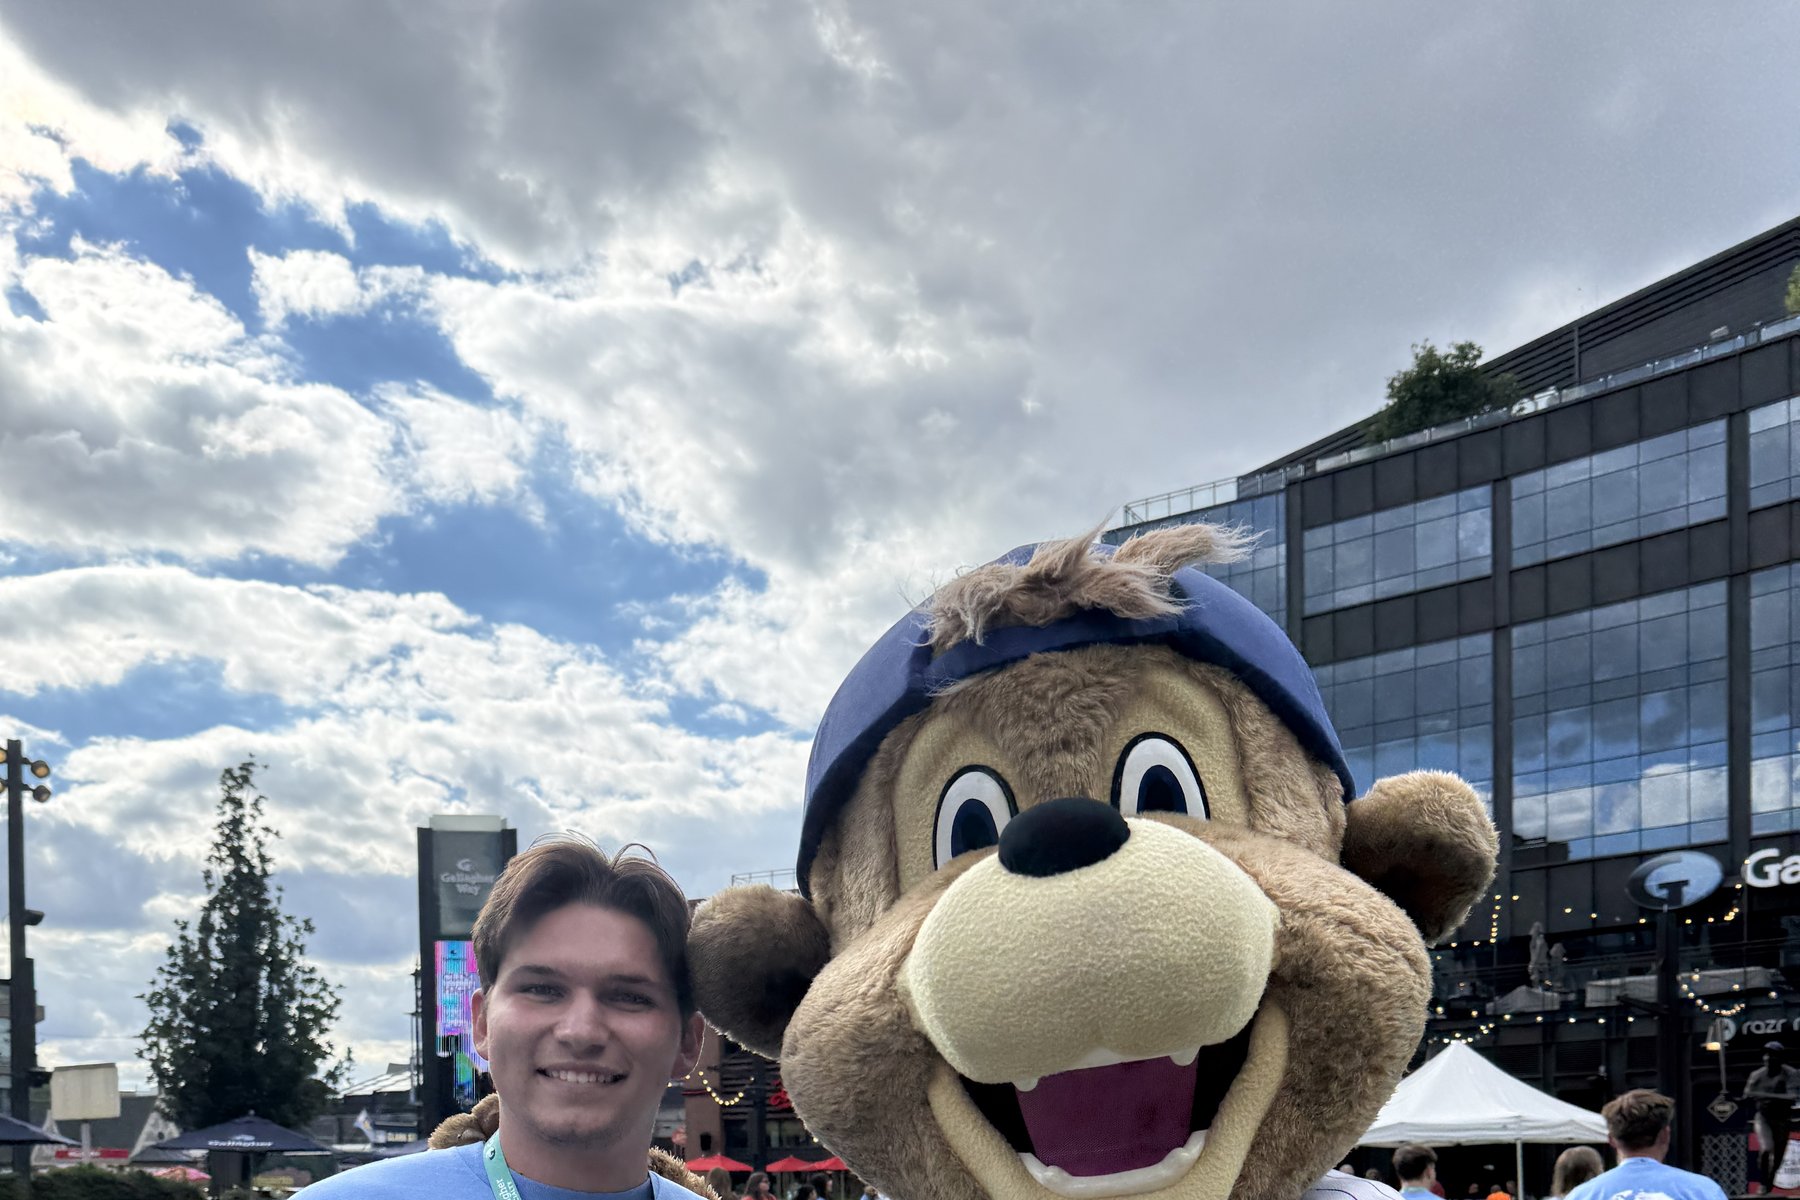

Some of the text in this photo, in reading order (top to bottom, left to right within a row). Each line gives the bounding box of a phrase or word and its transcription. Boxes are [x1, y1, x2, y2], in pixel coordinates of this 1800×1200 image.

[440, 871, 495, 885] Gallagher
[455, 884, 481, 896] Way
[1741, 1018, 1788, 1035] razr
